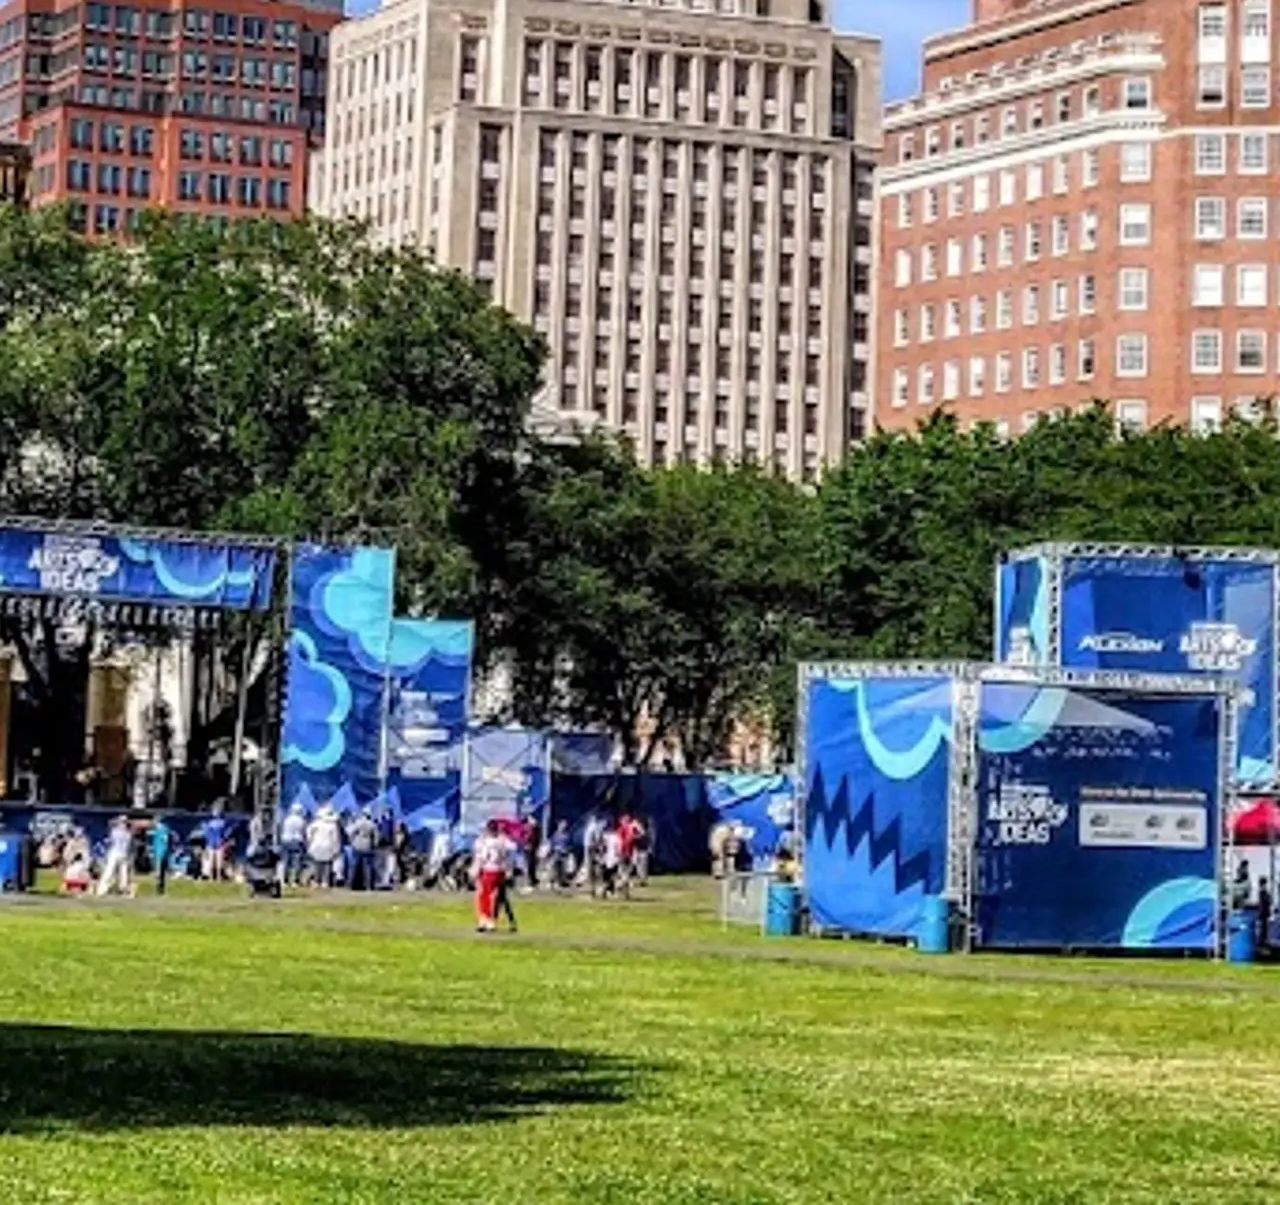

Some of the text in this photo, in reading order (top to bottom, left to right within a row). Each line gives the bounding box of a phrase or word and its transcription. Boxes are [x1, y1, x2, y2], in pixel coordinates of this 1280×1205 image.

[41, 571, 99, 592] IDEAS
[1189, 654, 1241, 670] IDEAS
[1000, 823, 1050, 844] IDEAS
